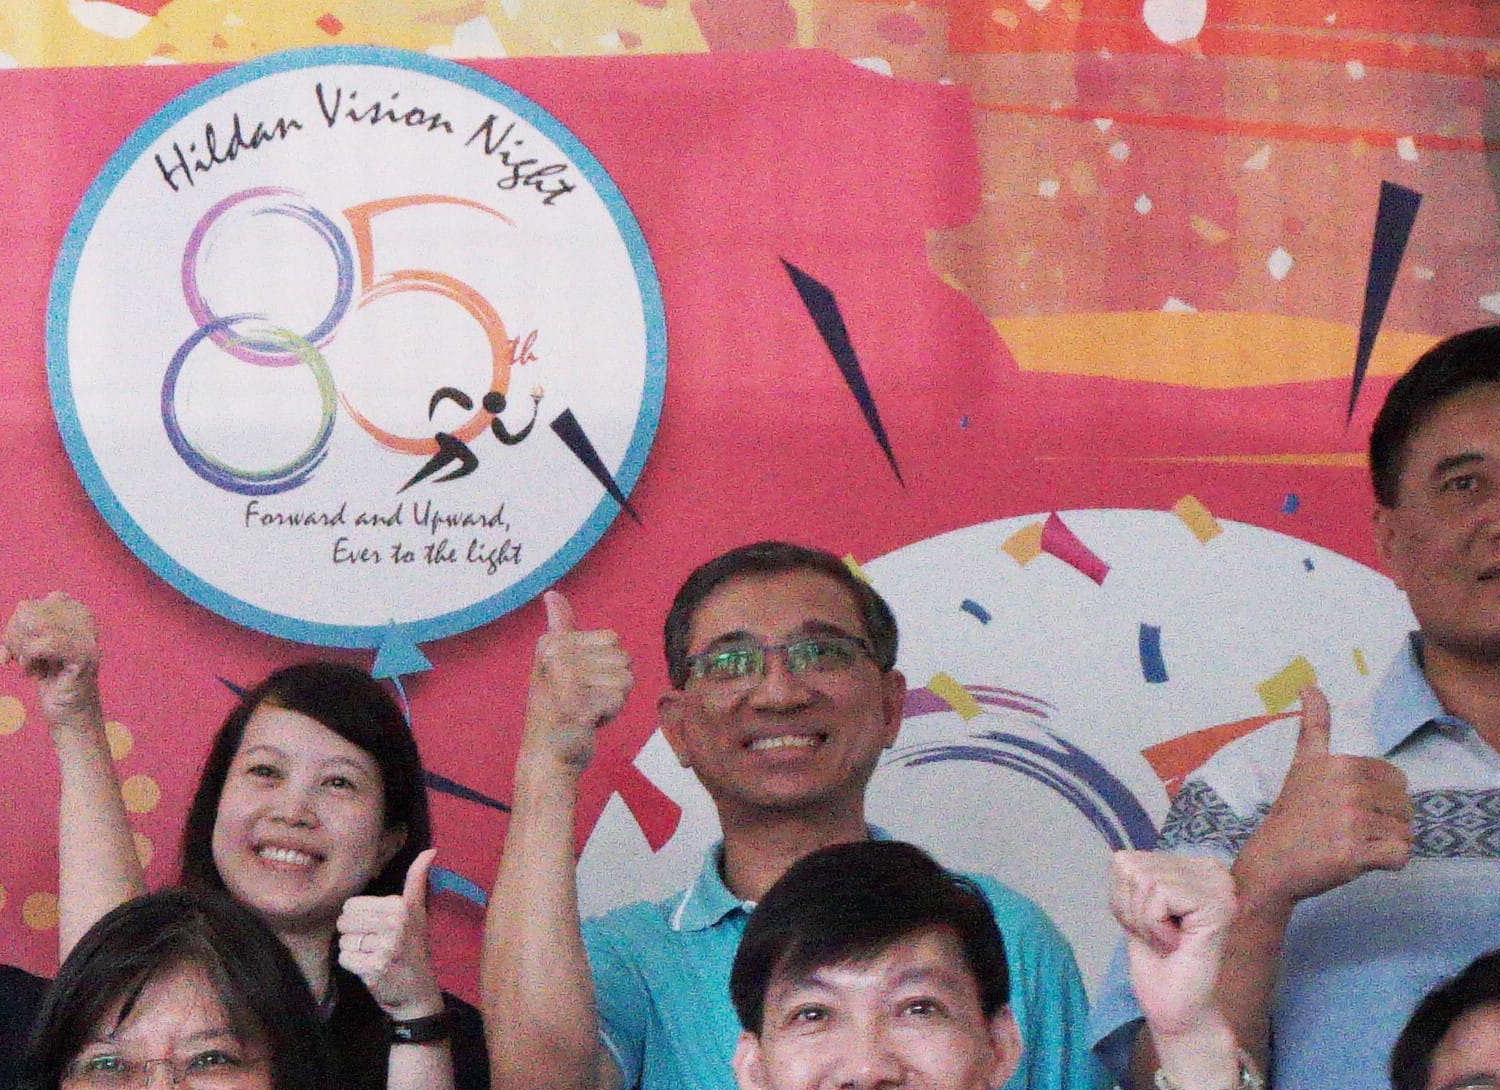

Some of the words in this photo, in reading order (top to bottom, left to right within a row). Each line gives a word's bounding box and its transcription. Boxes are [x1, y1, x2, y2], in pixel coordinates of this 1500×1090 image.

[155, 115, 303, 192] Hildan
[315, 83, 455, 134] Vision
[466, 114, 577, 206] Night
[244, 501, 347, 529] Forward
[354, 503, 402, 528] and
[412, 500, 512, 532] Upward,
[333, 537, 382, 566] Ever
[390, 540, 416, 563] to
[424, 539, 457, 563] the
[467, 538, 523, 572] light
